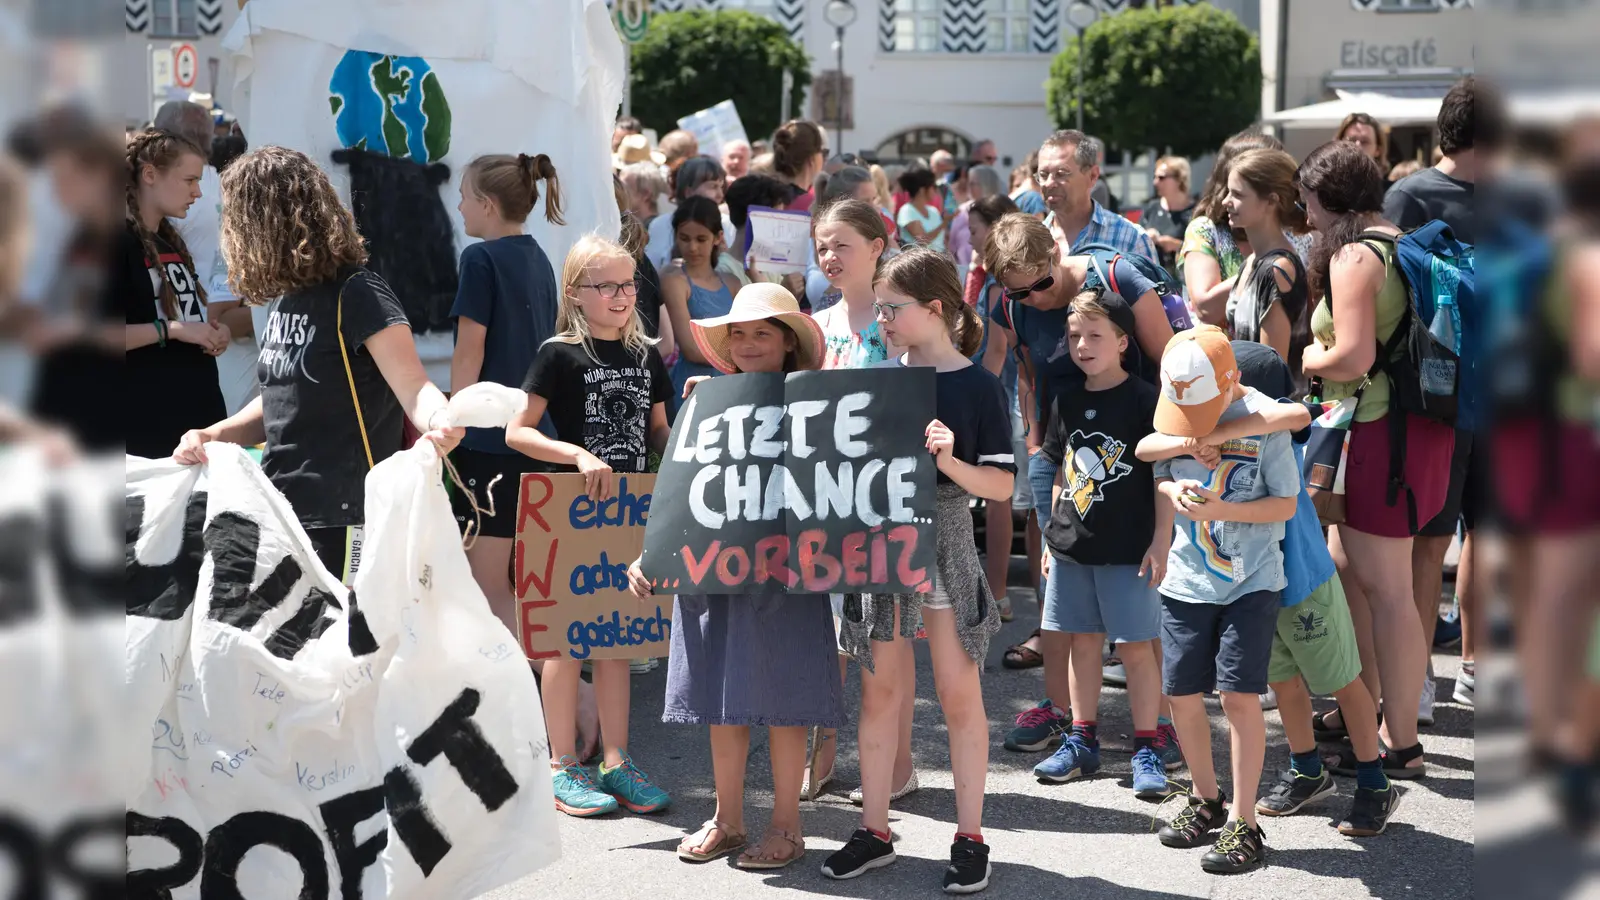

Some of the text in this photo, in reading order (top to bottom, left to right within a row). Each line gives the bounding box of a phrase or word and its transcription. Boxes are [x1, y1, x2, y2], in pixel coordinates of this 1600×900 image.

[1340, 37, 1437, 67] Eiscafé
[672, 391, 874, 464] LETZTE
[350, 540, 361, 573] GARCIA
[1294, 627, 1328, 643] Surfboard
[296, 761, 355, 791] Kerstin
